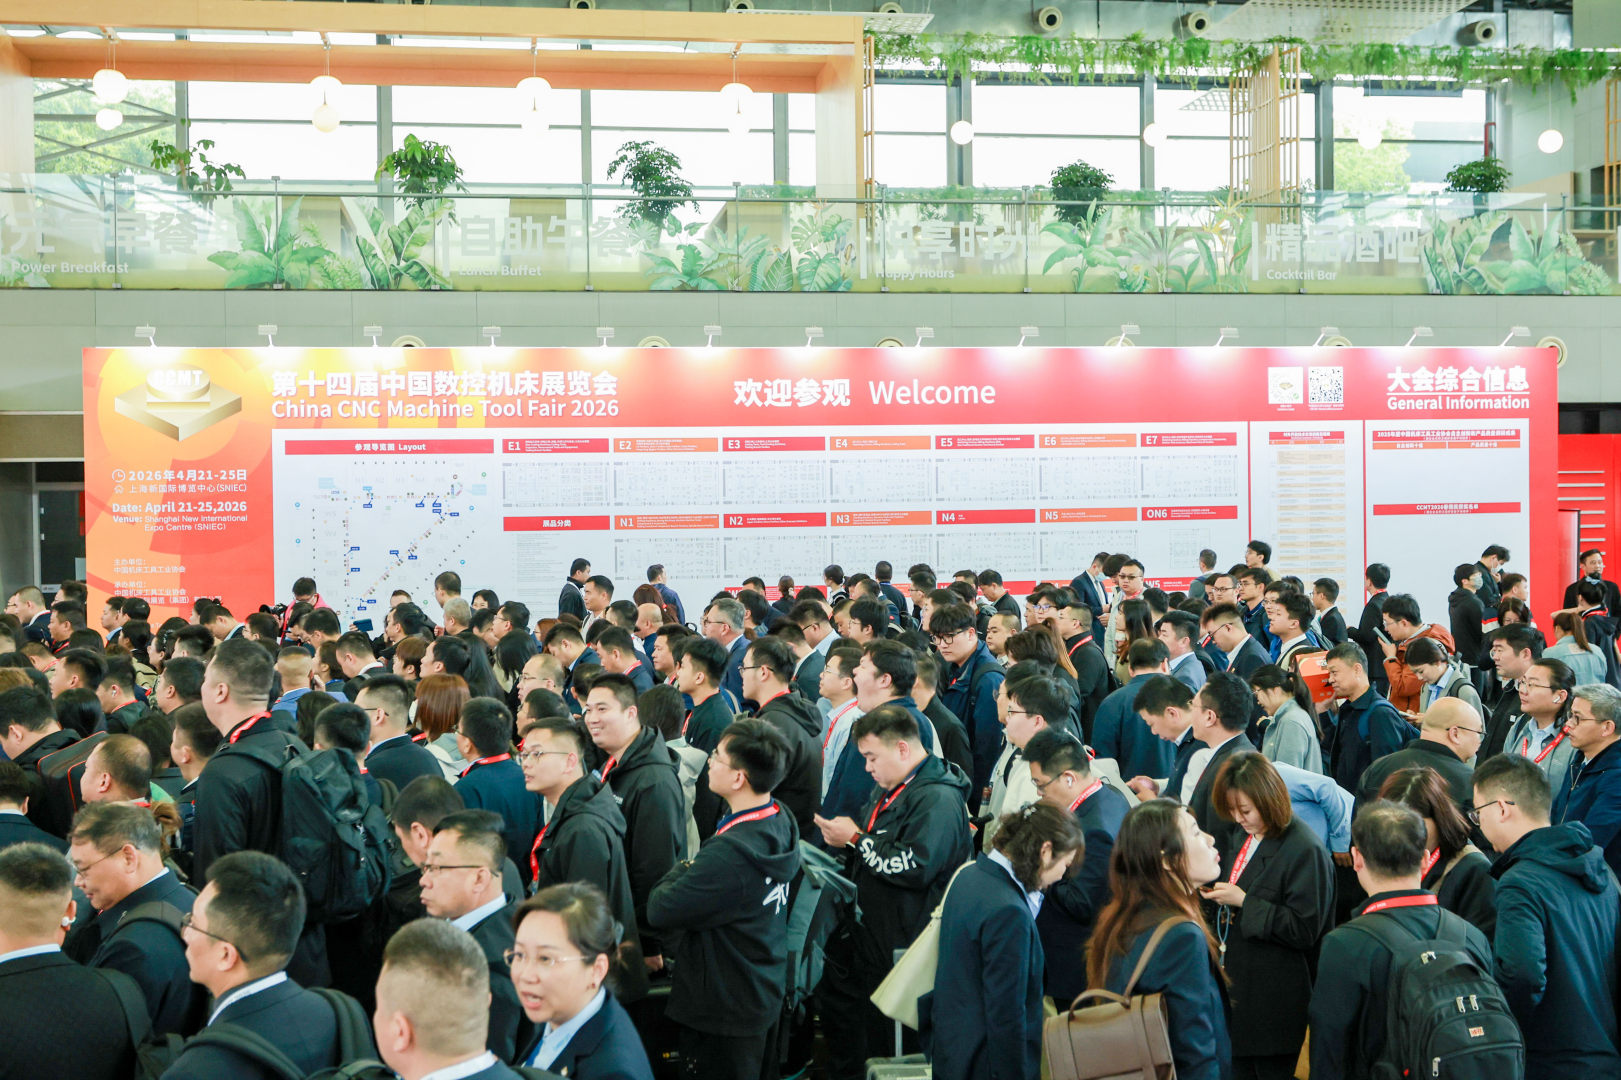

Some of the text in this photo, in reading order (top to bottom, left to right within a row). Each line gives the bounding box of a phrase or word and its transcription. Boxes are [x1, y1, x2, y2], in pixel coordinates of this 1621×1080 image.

[460, 215, 638, 257] 自助午餐
[1265, 223, 1420, 263] 精品酒吧
[11, 261, 129, 274] Power Breakfast
[501, 265, 542, 277] Buffet
[919, 267, 955, 279] Hours
[1266, 268, 1337, 280] Cocktail Bar
[1386, 365, 1530, 392] 大会综合信息
[271, 370, 618, 398] 第十四届中国数控机床展览会
[733, 377, 851, 408] 欢迎参观
[868, 379, 996, 406] Welcome
[1386, 394, 1530, 411] General Information
[271, 400, 619, 418] China CNC Machine Tool Fair 2026
[619, 440, 632, 450] E2
[728, 439, 741, 449] E3
[835, 438, 848, 448] E4
[940, 437, 953, 447] E5
[1044, 436, 1057, 446] E6
[1145, 435, 1158, 445] E7
[398, 444, 426, 452] Layout
[508, 441, 521, 451] E1
[128, 469, 248, 481] 2026年4月21-25日
[112, 501, 247, 514] Date: April 21-25,2026
[941, 513, 955, 522] N4
[1045, 511, 1058, 520] N5
[1146, 509, 1167, 518] ON6
[112, 515, 143, 523] Venue:
[144, 515, 180, 524] Shanghai
[200, 514, 248, 522] International
[620, 517, 634, 527] N1
[729, 516, 743, 526] N2
[836, 515, 850, 525] N3
[144, 523, 226, 532] Expo Centre (SNIEC)
